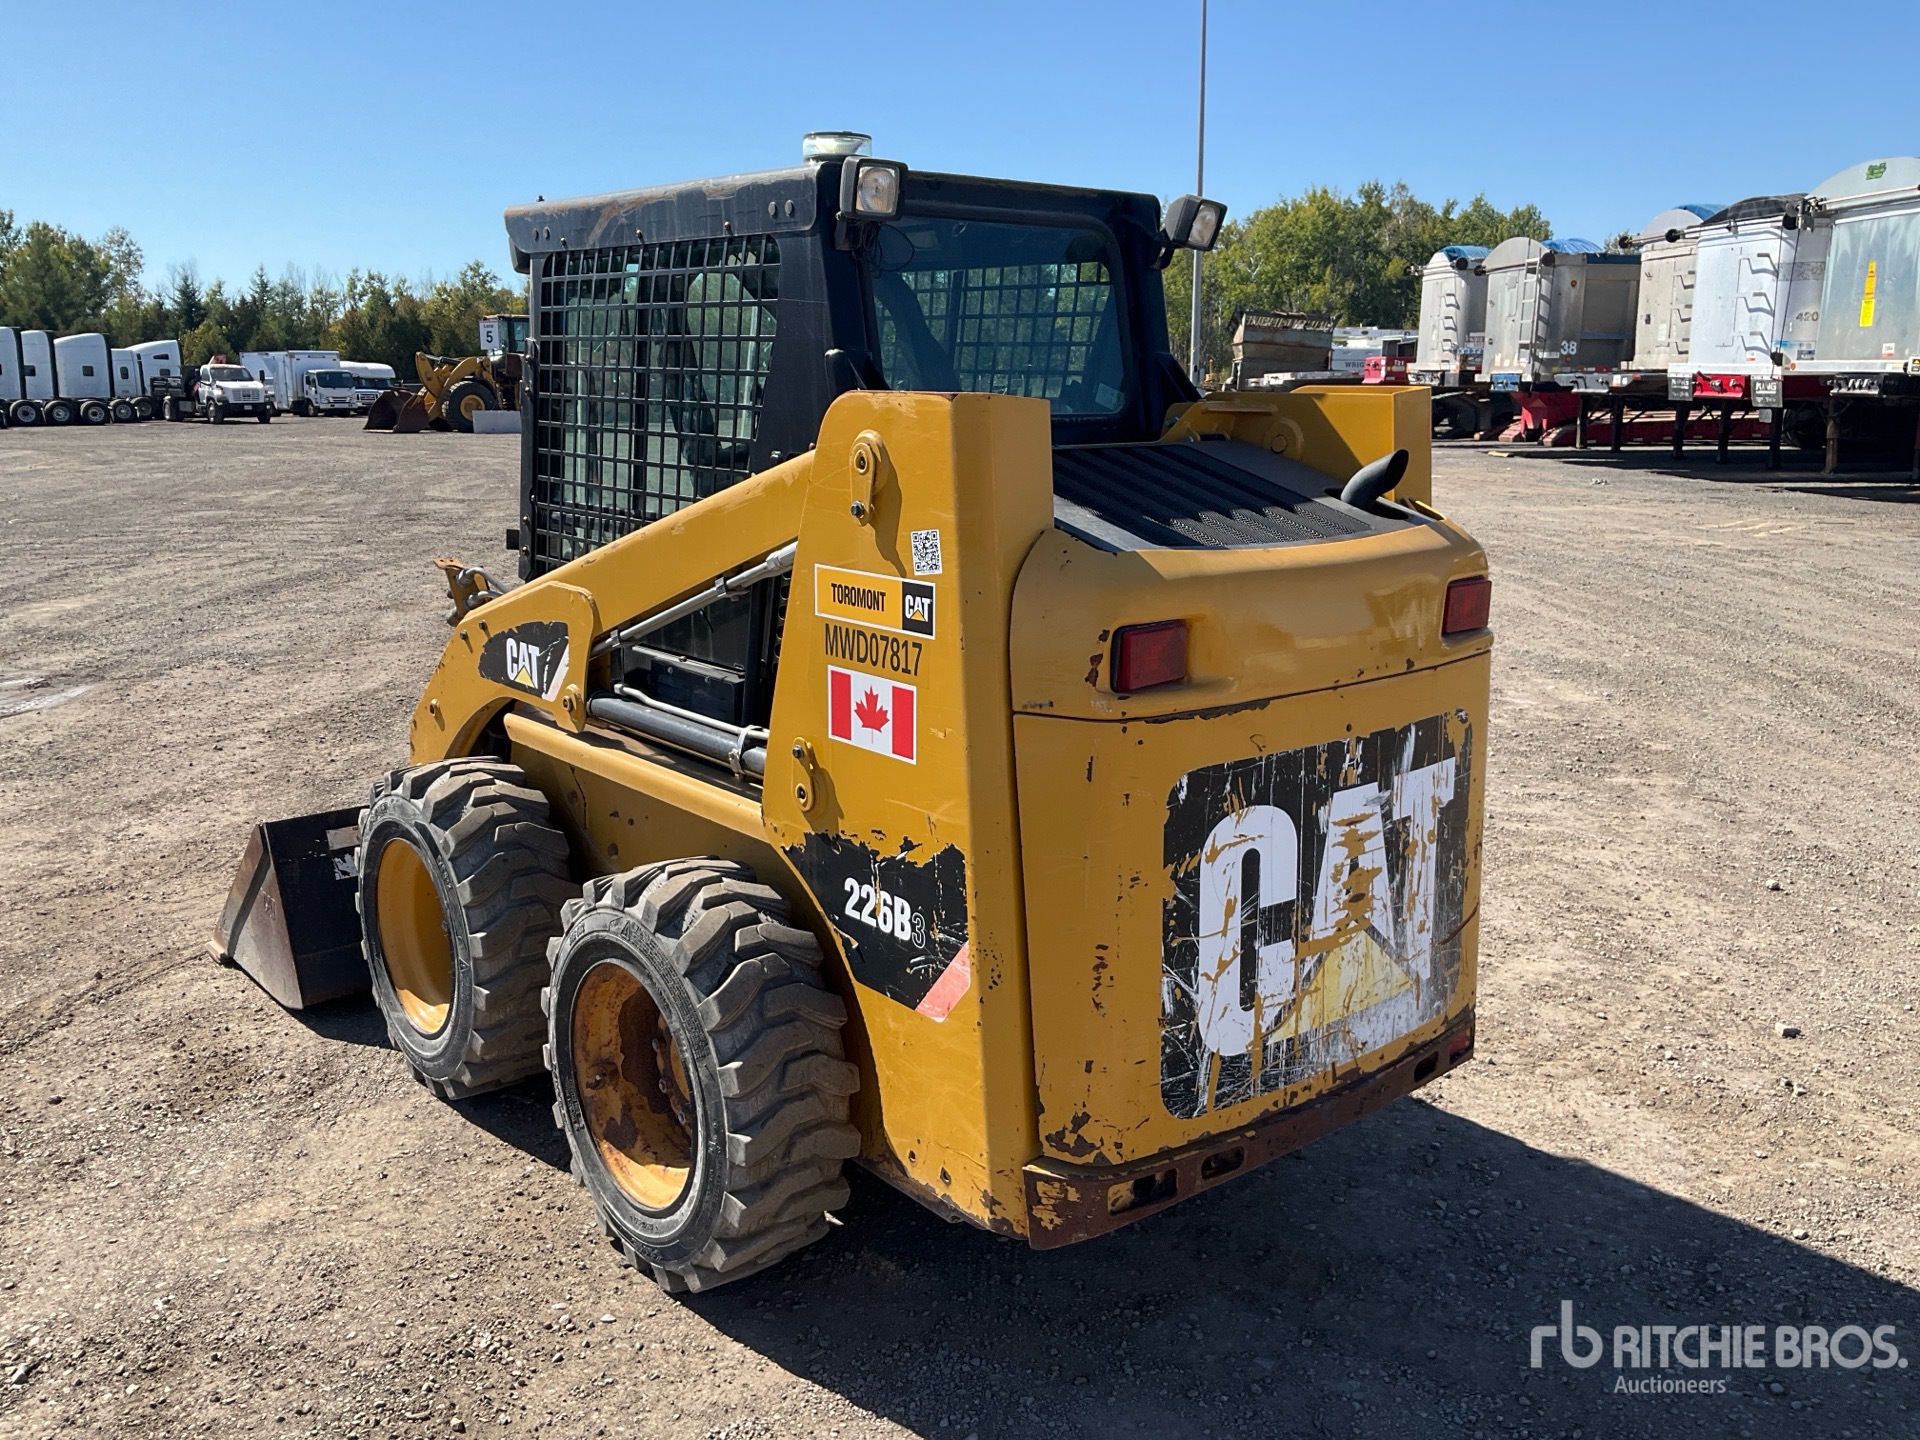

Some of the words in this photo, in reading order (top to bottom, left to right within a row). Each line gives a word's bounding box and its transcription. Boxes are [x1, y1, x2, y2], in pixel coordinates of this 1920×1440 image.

[1796, 311, 1819, 322] 420
[486, 330, 493, 344] 5
[1560, 340, 1577, 355] 38
[1755, 382, 1777, 391] KING
[830, 583, 887, 612] TOROMONT
[904, 594, 932, 622] CAT
[824, 622, 923, 677] MWD07817
[506, 637, 540, 690] CAT
[1199, 756, 1456, 1056] CAT
